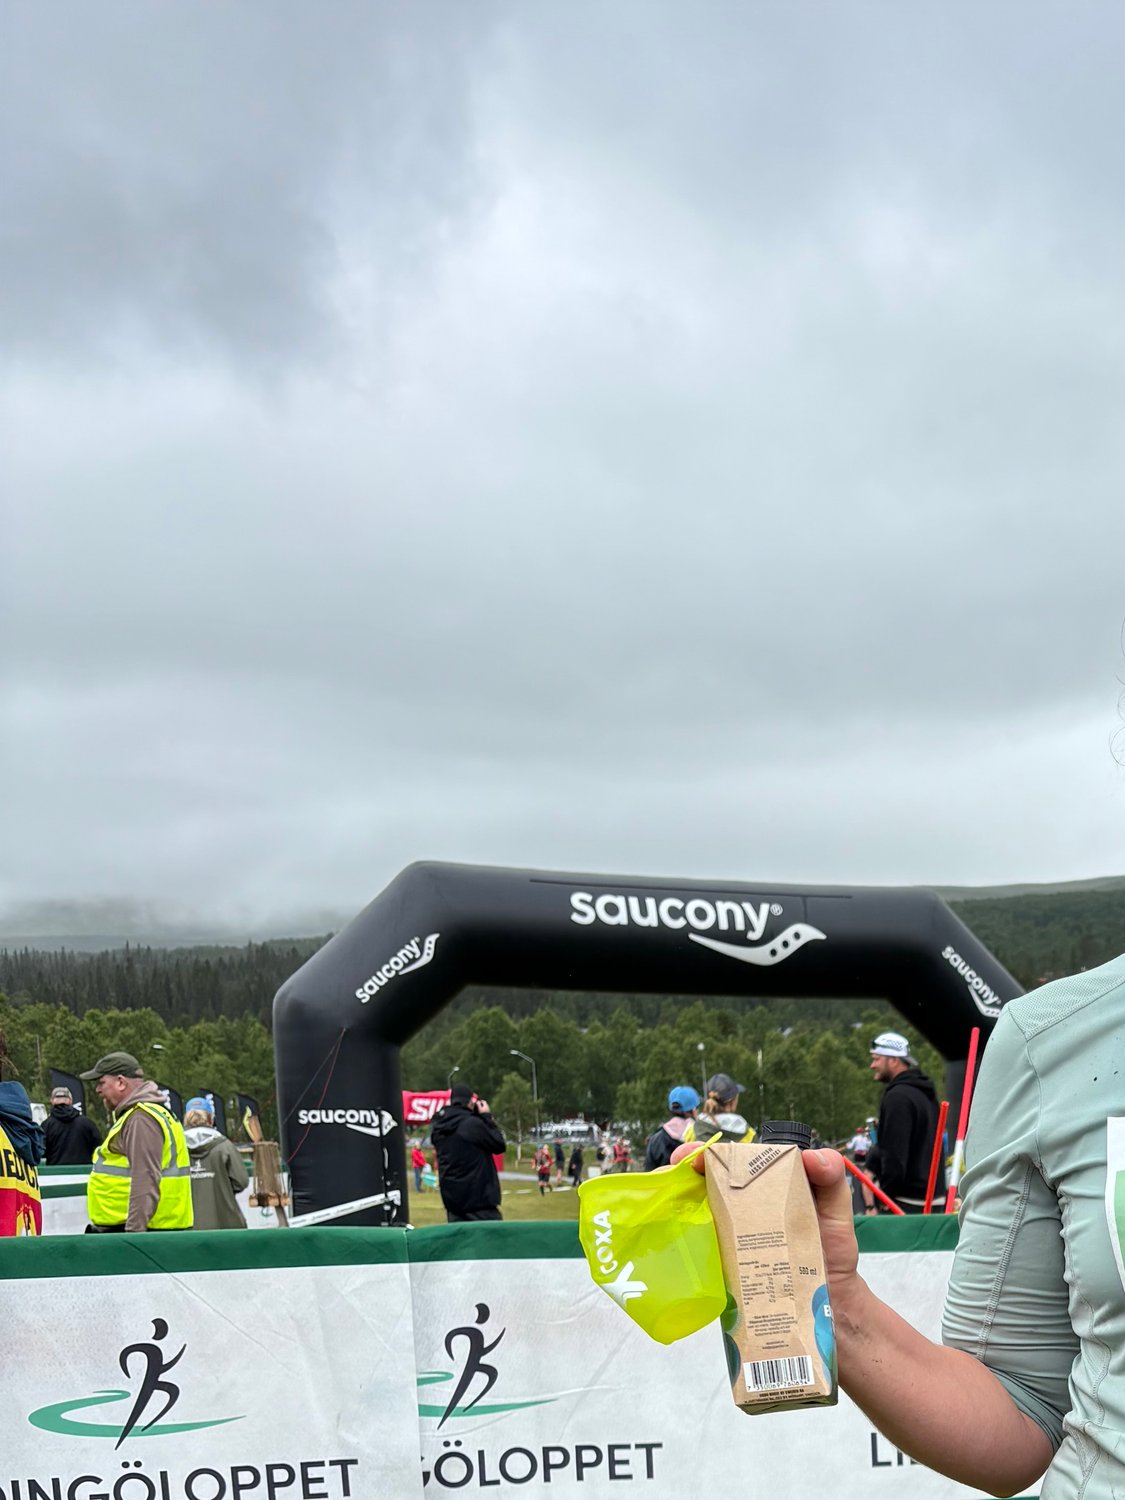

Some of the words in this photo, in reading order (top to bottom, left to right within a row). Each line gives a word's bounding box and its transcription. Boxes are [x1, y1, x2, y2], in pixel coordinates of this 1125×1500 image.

[355, 937, 420, 1003] saucony
[942, 946, 999, 1004] saucony
[298, 1109, 379, 1127] saucony
[593, 1210, 618, 1275] COXA
